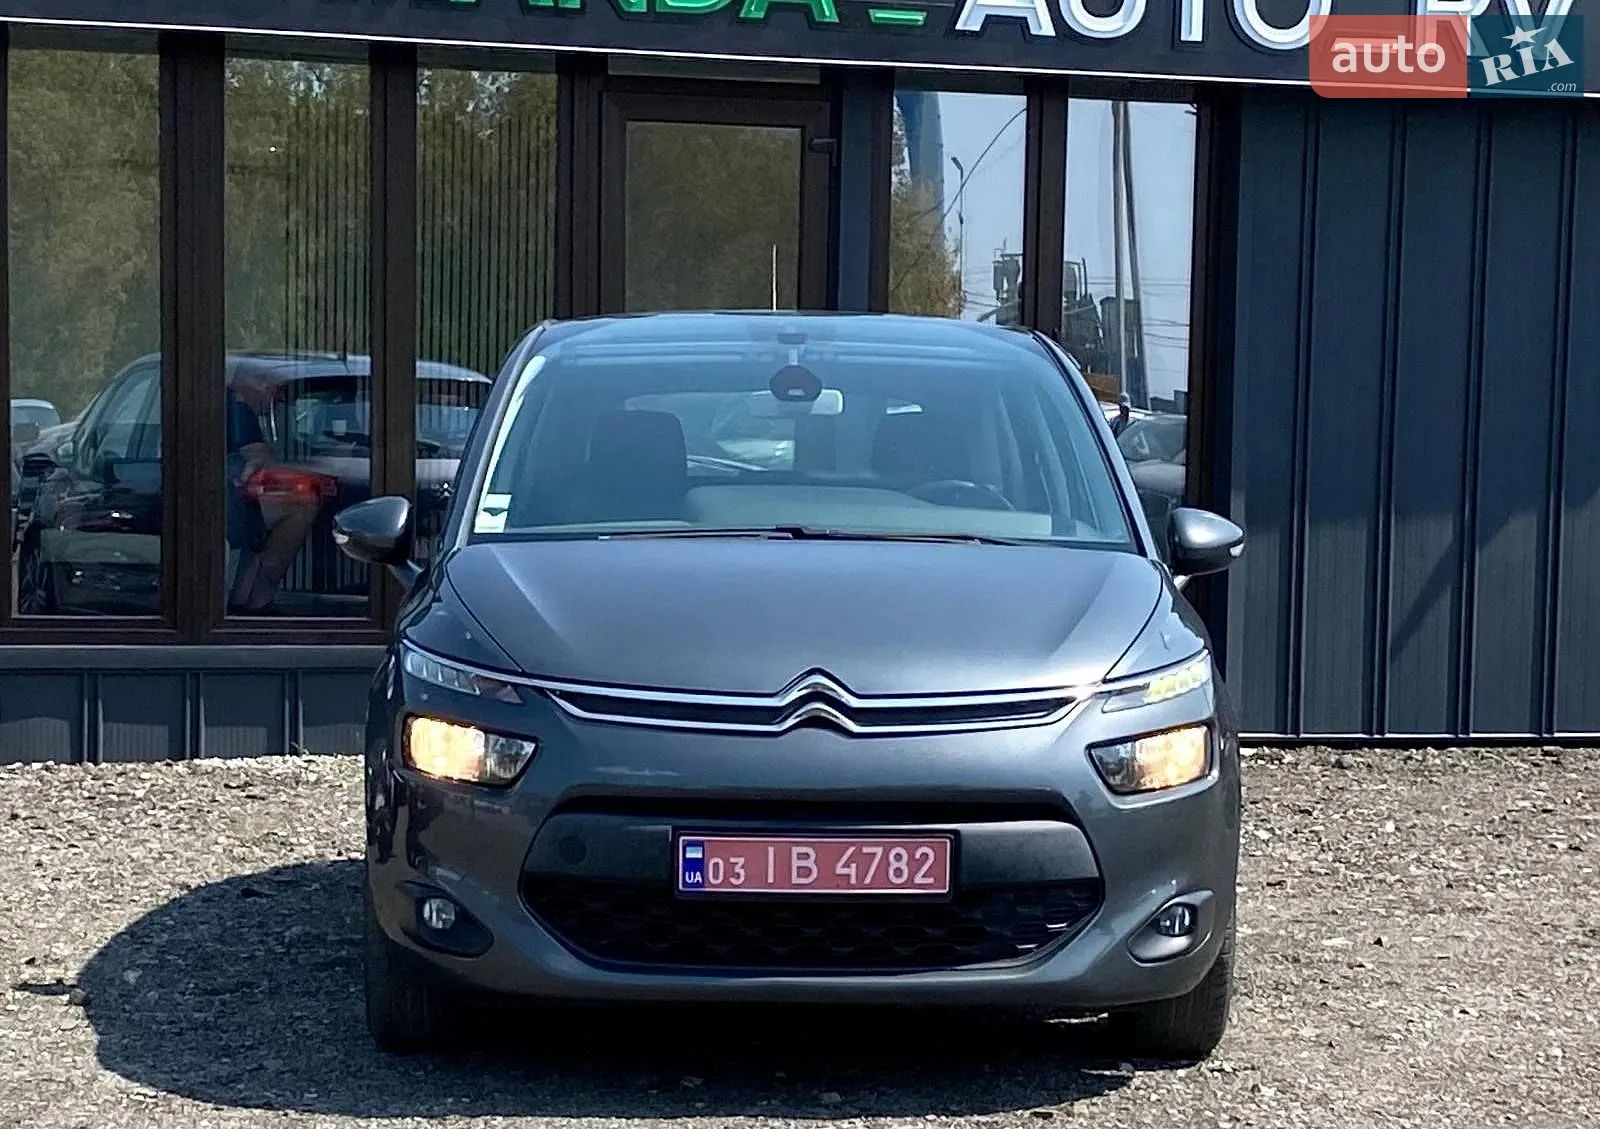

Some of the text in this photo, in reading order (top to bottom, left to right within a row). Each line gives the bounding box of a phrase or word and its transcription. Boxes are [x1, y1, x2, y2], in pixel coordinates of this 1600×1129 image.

[685, 871, 703, 883] UA
[708, 857, 746, 885] 03
[835, 846, 935, 885] 4782
